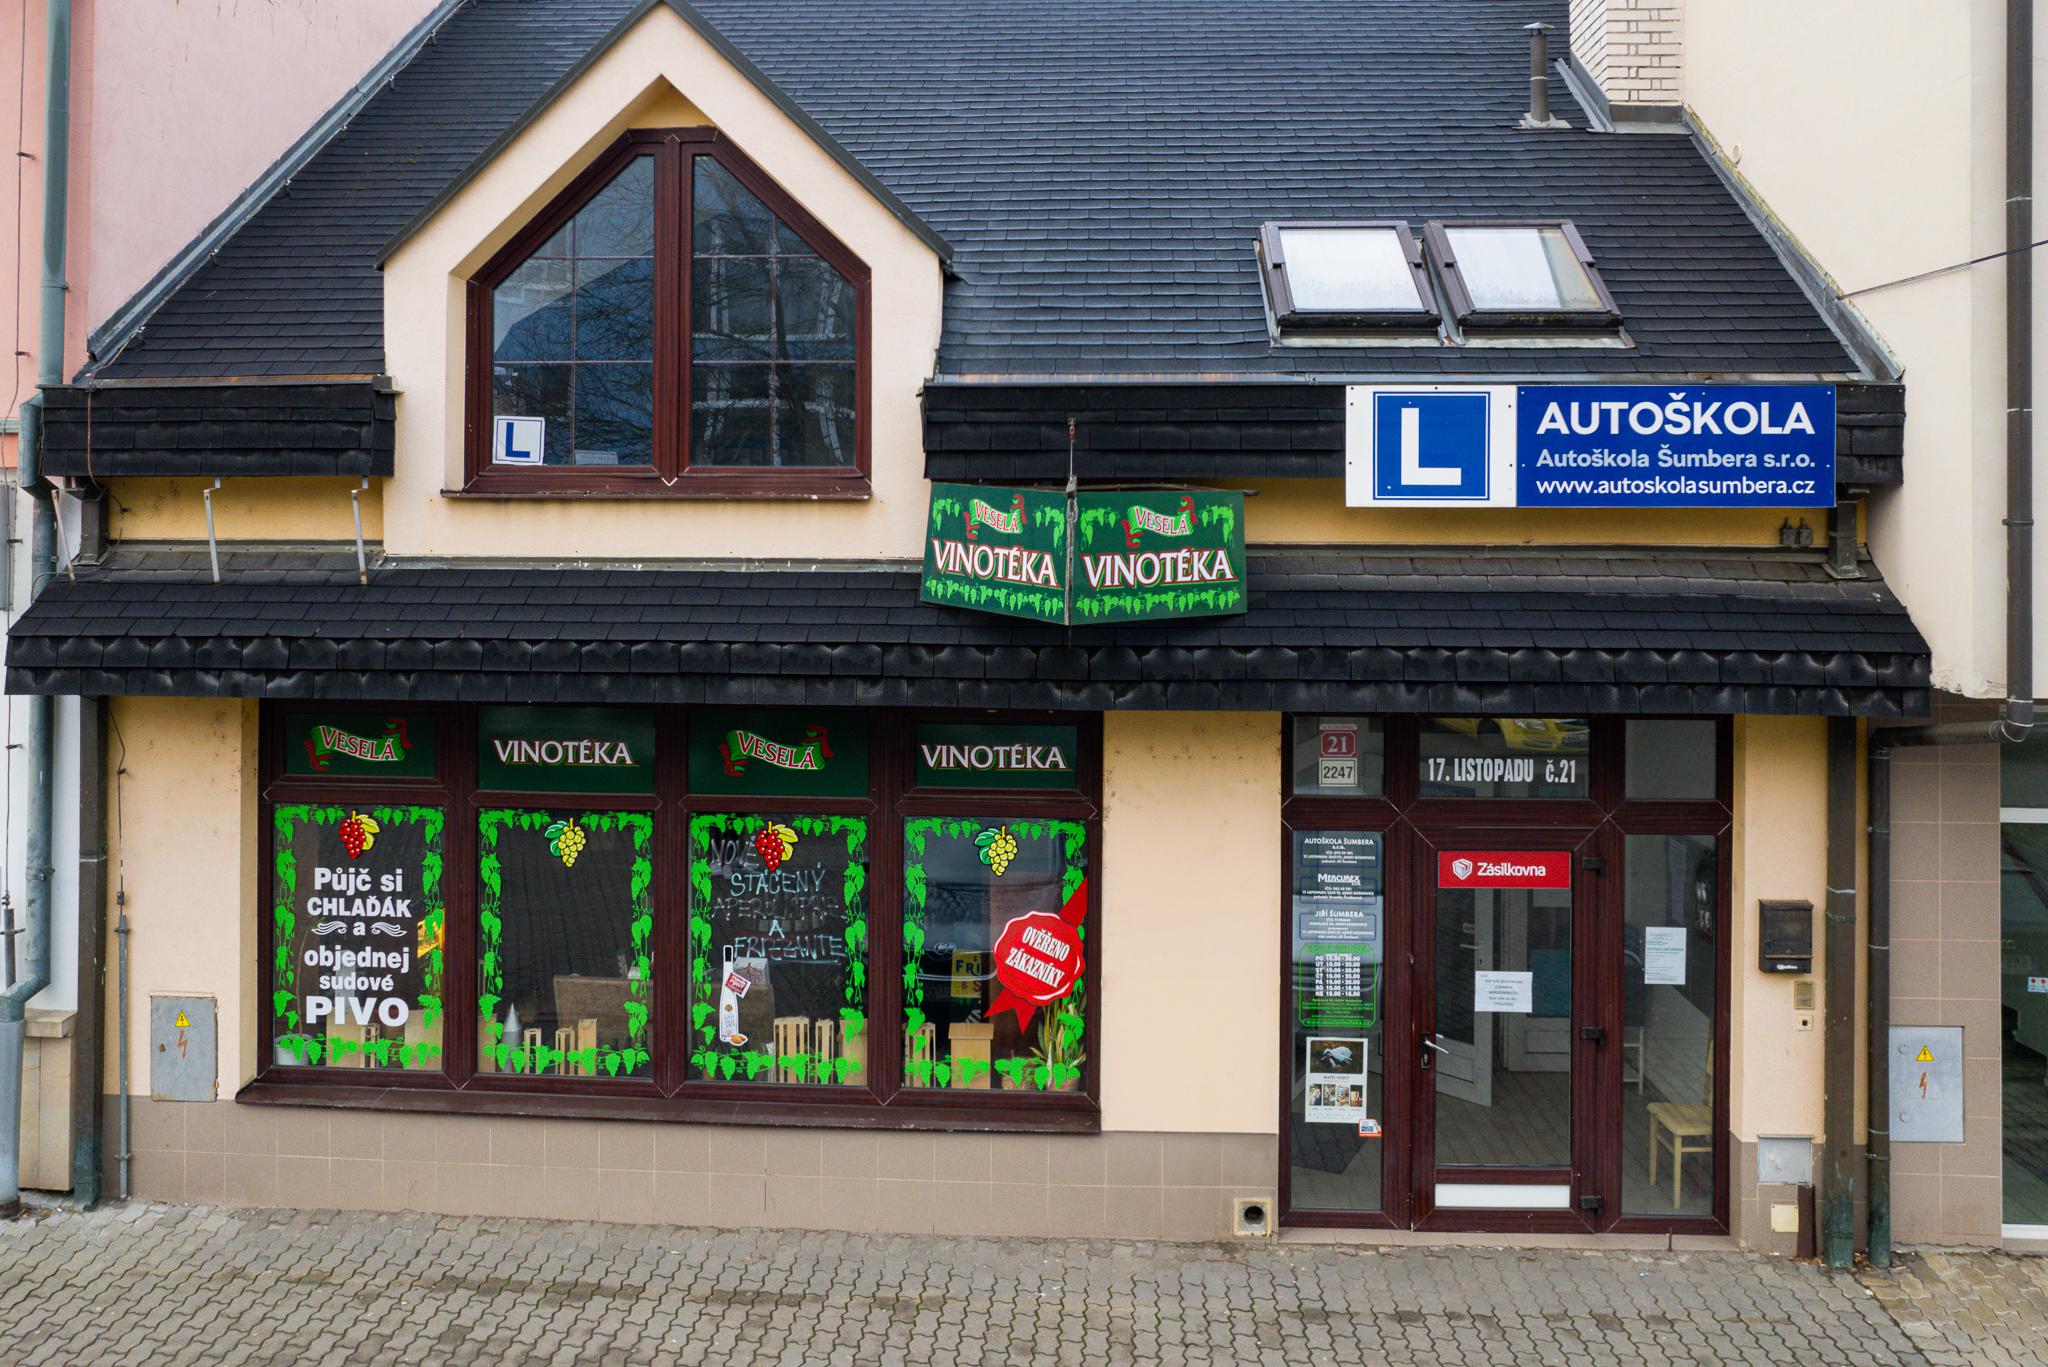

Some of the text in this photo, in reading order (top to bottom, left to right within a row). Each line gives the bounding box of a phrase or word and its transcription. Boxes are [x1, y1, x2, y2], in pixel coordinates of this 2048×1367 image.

[1537, 393, 1815, 435] AUTOŠKOLA
[505, 422, 531, 458] L
[1401, 408, 1462, 486] L
[1536, 445, 1815, 468] Autoškola Šumbera s.r.o.
[1536, 476, 1815, 496] www.autoskolasumbera.cz
[974, 500, 1020, 533] VESELÁ
[1134, 507, 1190, 536] VESELÁ
[932, 539, 1059, 588] VINOTÉKA
[1083, 547, 1235, 589] VINOTÉKA
[319, 726, 398, 762] VESELÁ
[493, 738, 634, 766] VINOTÉKA
[736, 730, 818, 769] VESELÁ
[920, 743, 1067, 769] VINOTÉKA
[1327, 735, 1348, 753] 21
[1323, 766, 1353, 779] 2247
[1428, 757, 1576, 783] 17. LISTOPADU č.21
[1304, 837, 1374, 846] AUTOŠKOLA ŠUMBERA
[314, 867, 403, 896] Půjč si
[1477, 862, 1547, 877] Zásilkovna
[307, 895, 412, 918] CHLAĎÁK
[1329, 909, 1364, 918] ŠUMBERA
[353, 921, 366, 936] a
[768, 919, 785, 939] A
[1022, 926, 1071, 962] OVĚŘENO
[304, 945, 410, 974] objednej
[1004, 947, 1065, 988] ZÁKAZNÍKY
[319, 972, 395, 991] sudové
[306, 996, 410, 1027] PIVO
